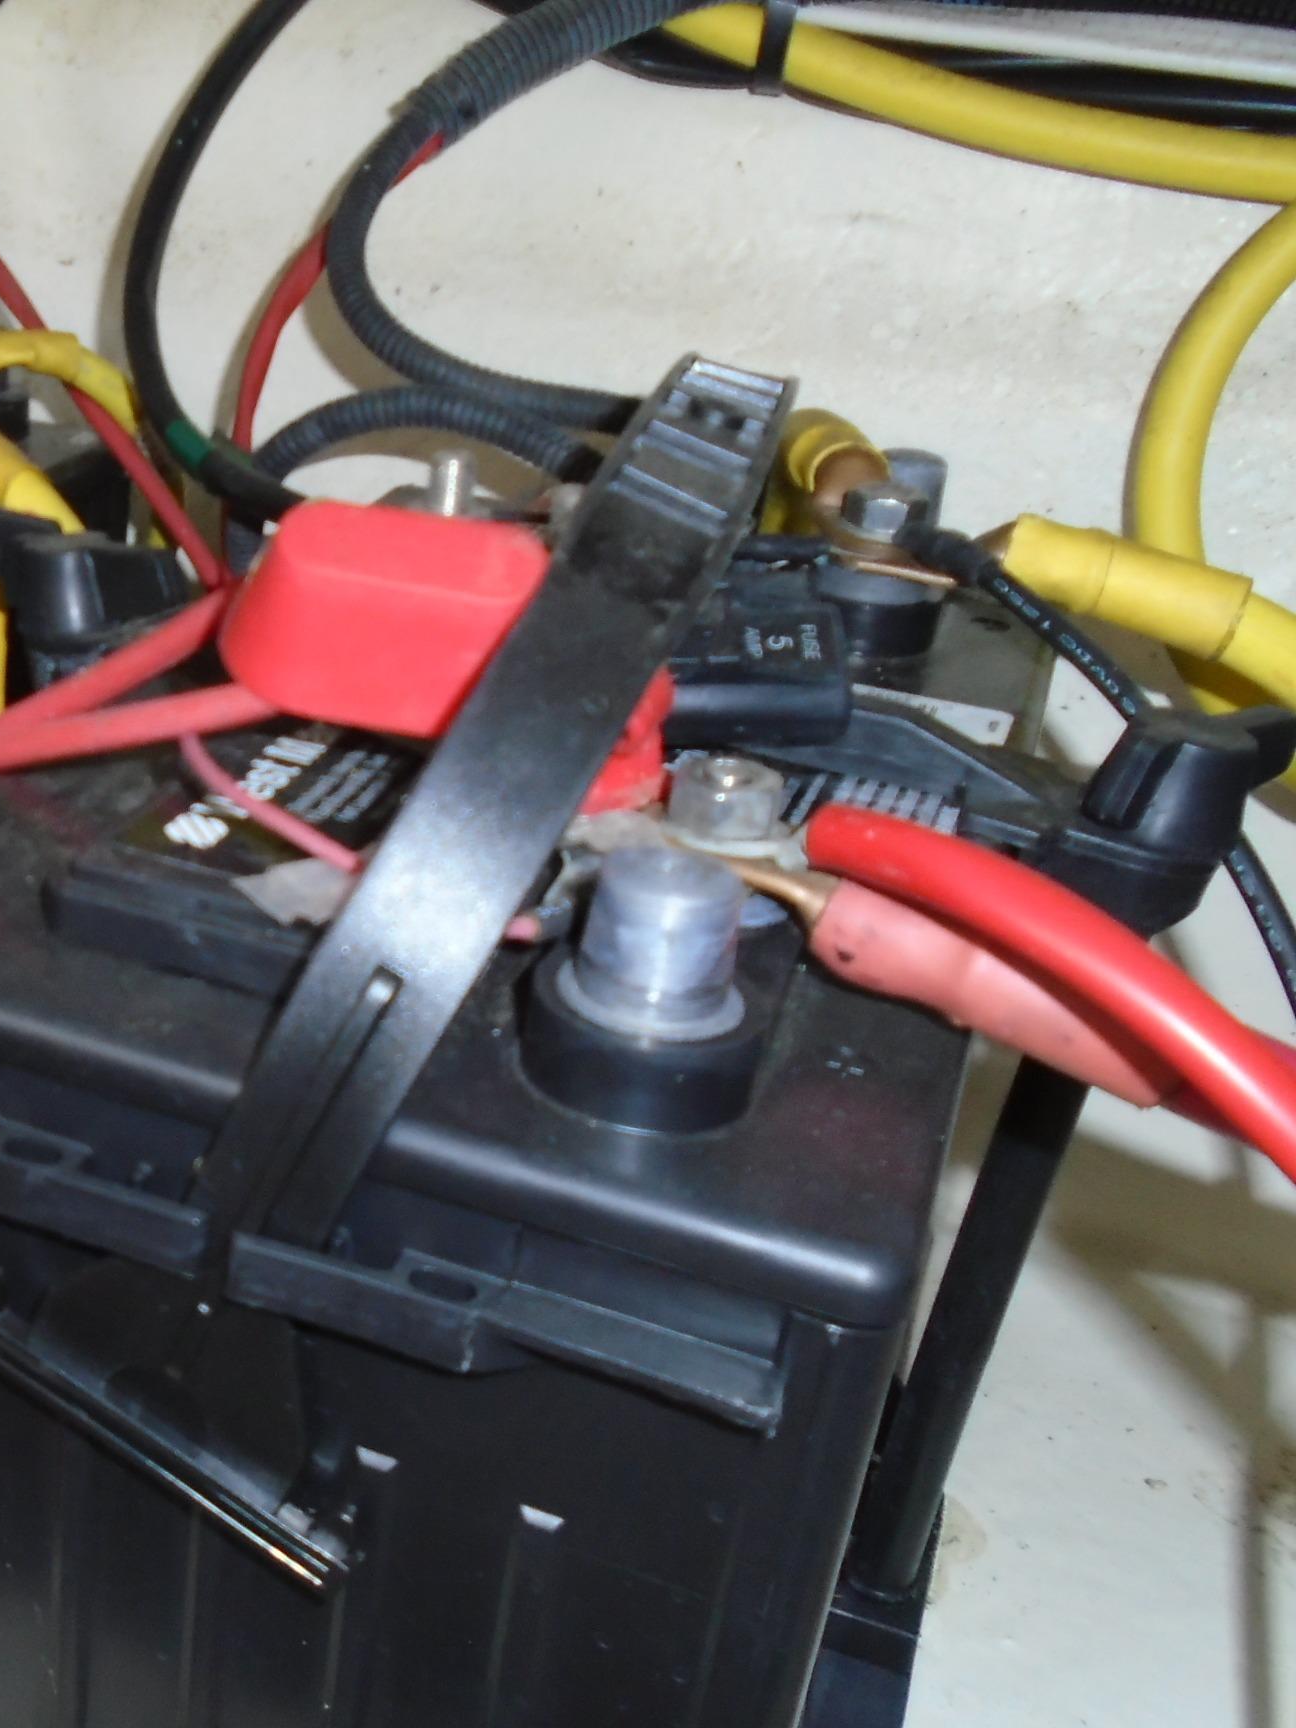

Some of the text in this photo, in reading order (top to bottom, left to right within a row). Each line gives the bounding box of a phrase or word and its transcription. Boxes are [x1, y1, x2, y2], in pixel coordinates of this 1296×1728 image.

[743, 625, 763, 659] AMP
[766, 634, 794, 651] 5
[800, 623, 823, 661] FUSE
